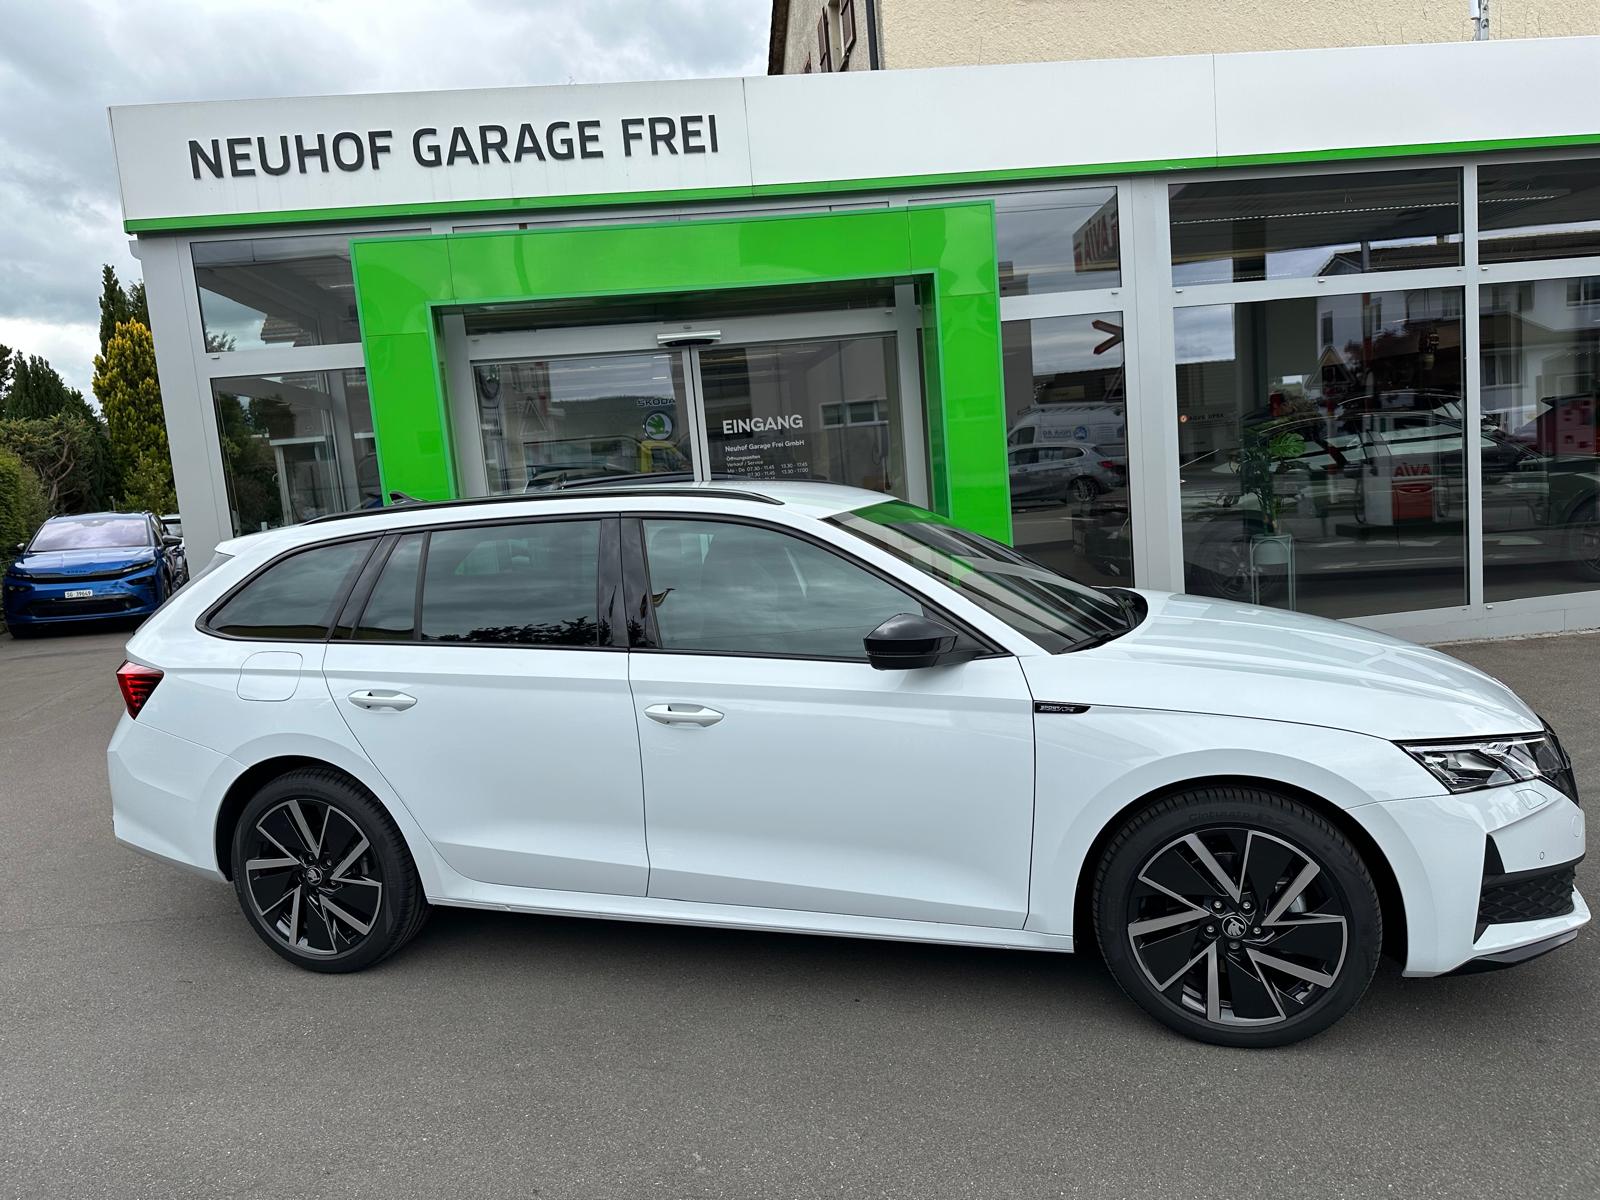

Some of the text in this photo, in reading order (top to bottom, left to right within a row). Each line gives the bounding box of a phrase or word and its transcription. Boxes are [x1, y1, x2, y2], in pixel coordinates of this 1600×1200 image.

[188, 114, 720, 180] NEUHOF GARAGE FREI
[722, 414, 804, 434] EINGANG
[725, 444, 747, 452] Neuhof
